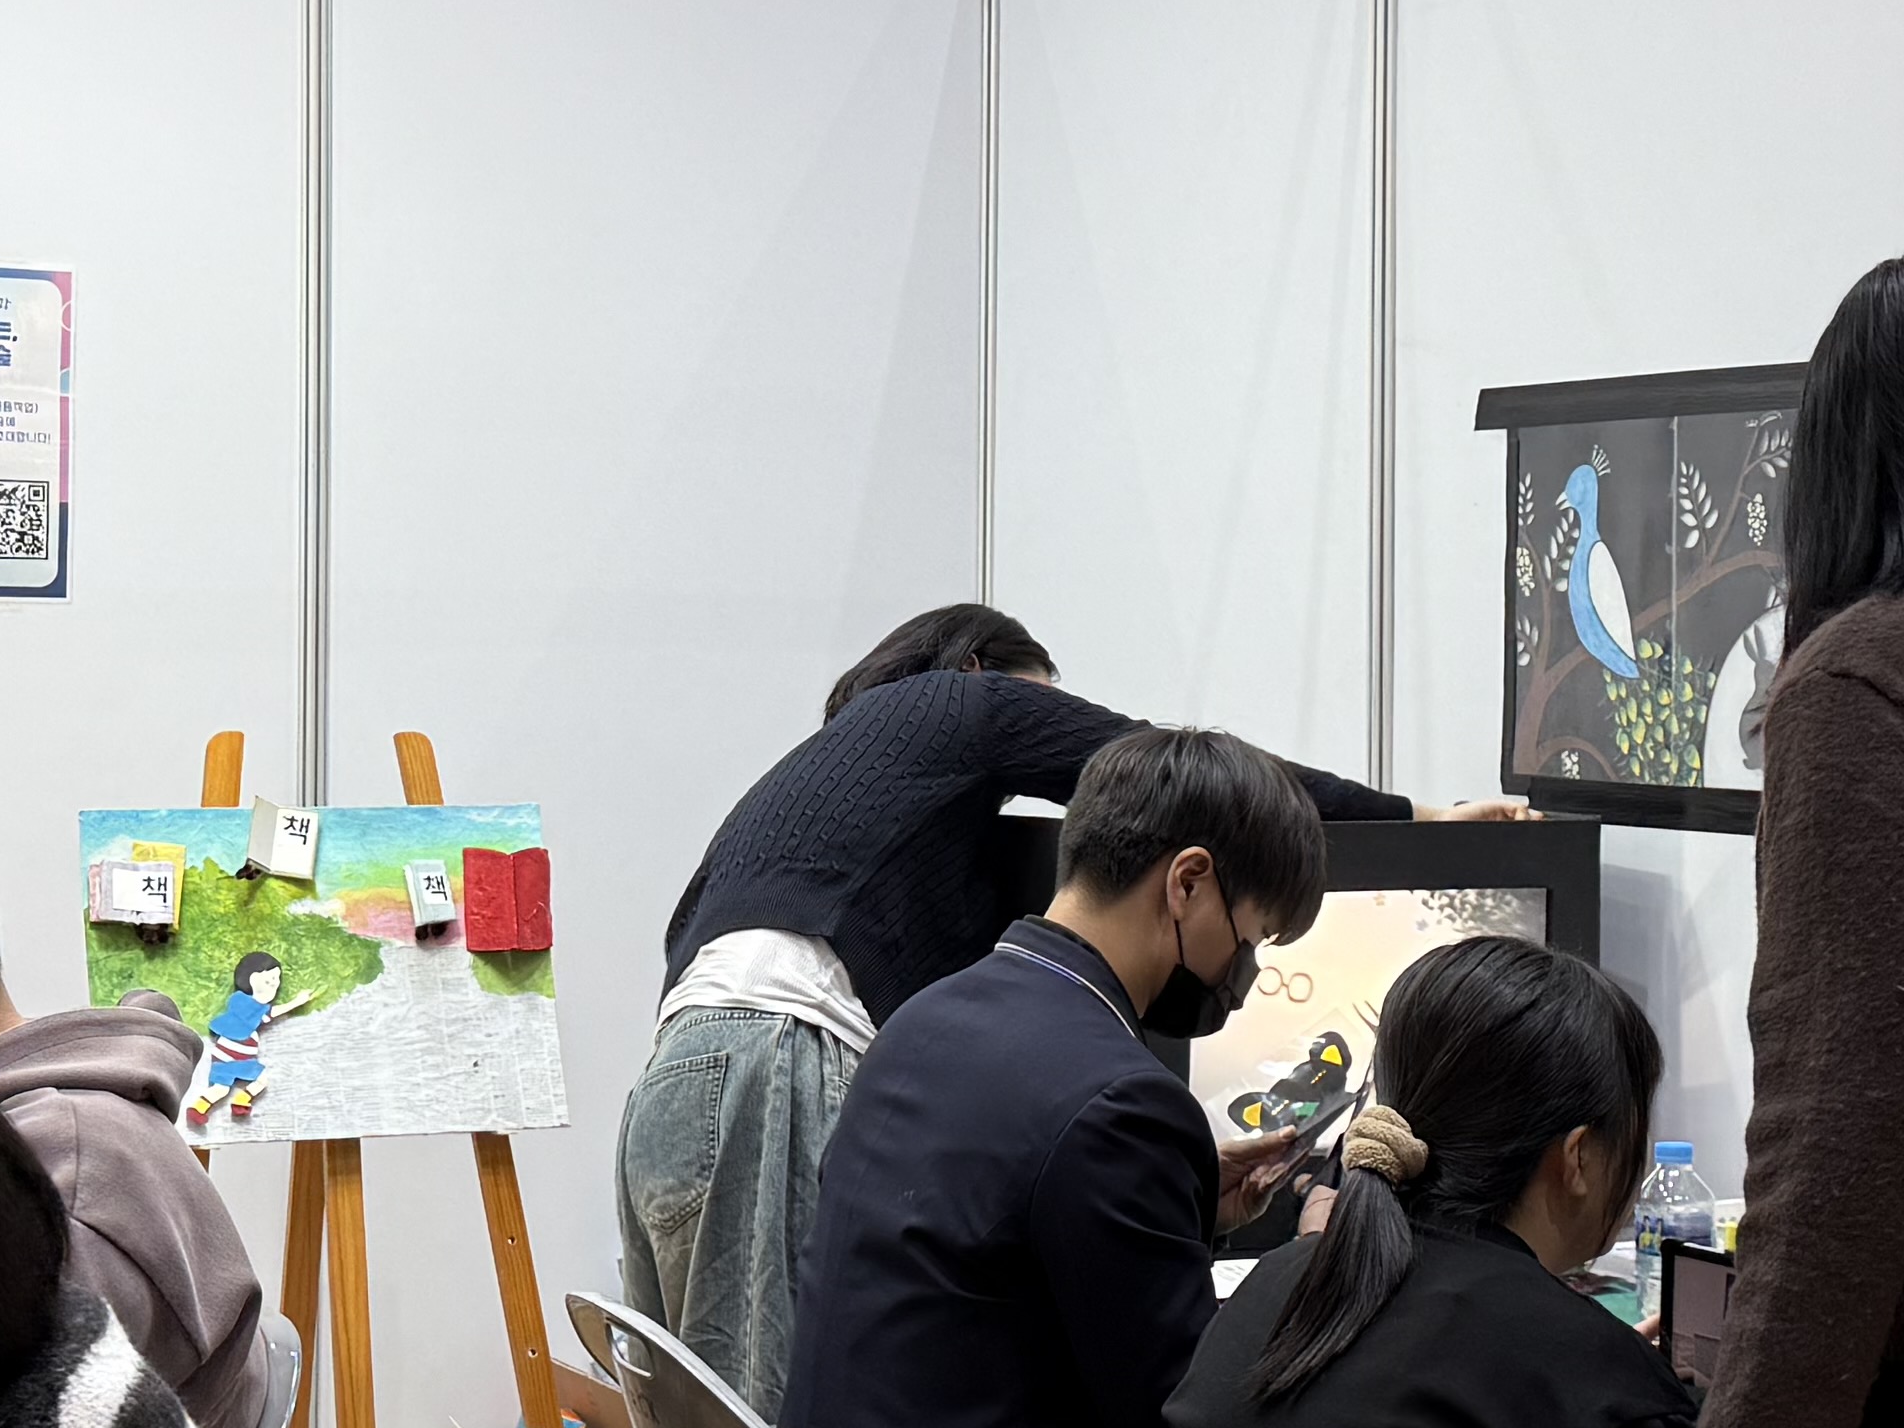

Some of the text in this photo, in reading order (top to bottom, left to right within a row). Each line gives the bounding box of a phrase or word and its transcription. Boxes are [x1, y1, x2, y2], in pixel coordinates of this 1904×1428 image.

[283, 815, 310, 846] 책
[141, 876, 168, 903] 책
[424, 875, 448, 901] 책
